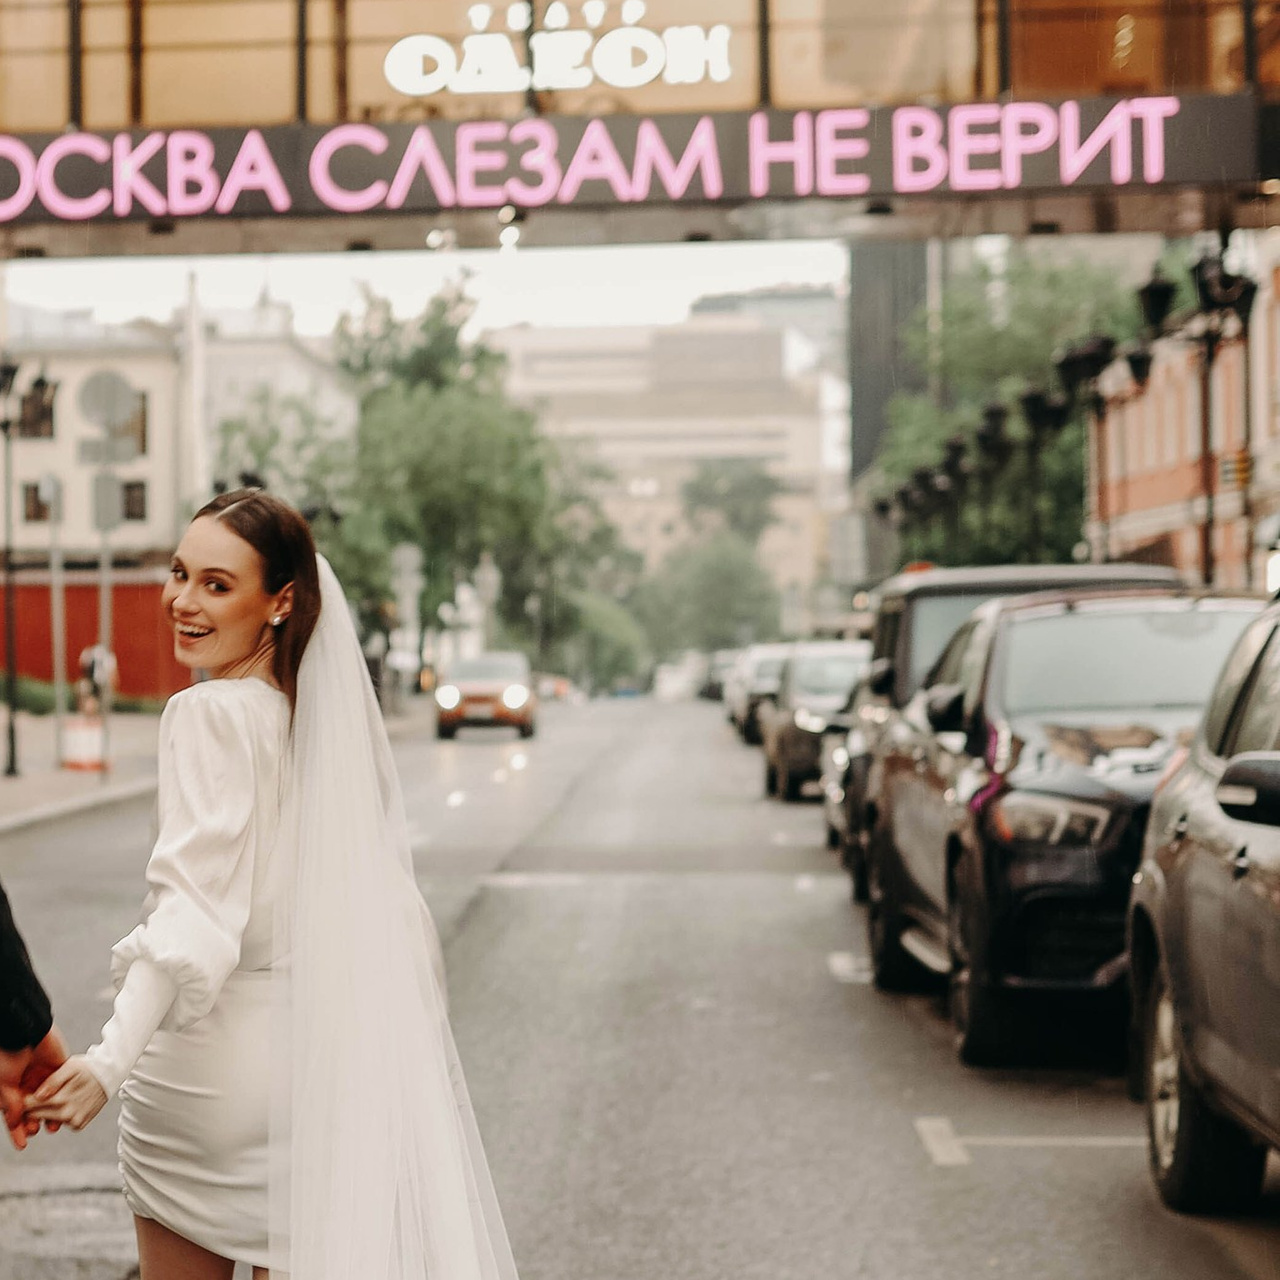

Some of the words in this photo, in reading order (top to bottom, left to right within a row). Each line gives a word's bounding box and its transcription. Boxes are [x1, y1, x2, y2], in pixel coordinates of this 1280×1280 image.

[308, 116, 723, 211] СЛЕЗАМ
[748, 108, 870, 197] НЕ
[892, 95, 1181, 193] ВЕРИТ
